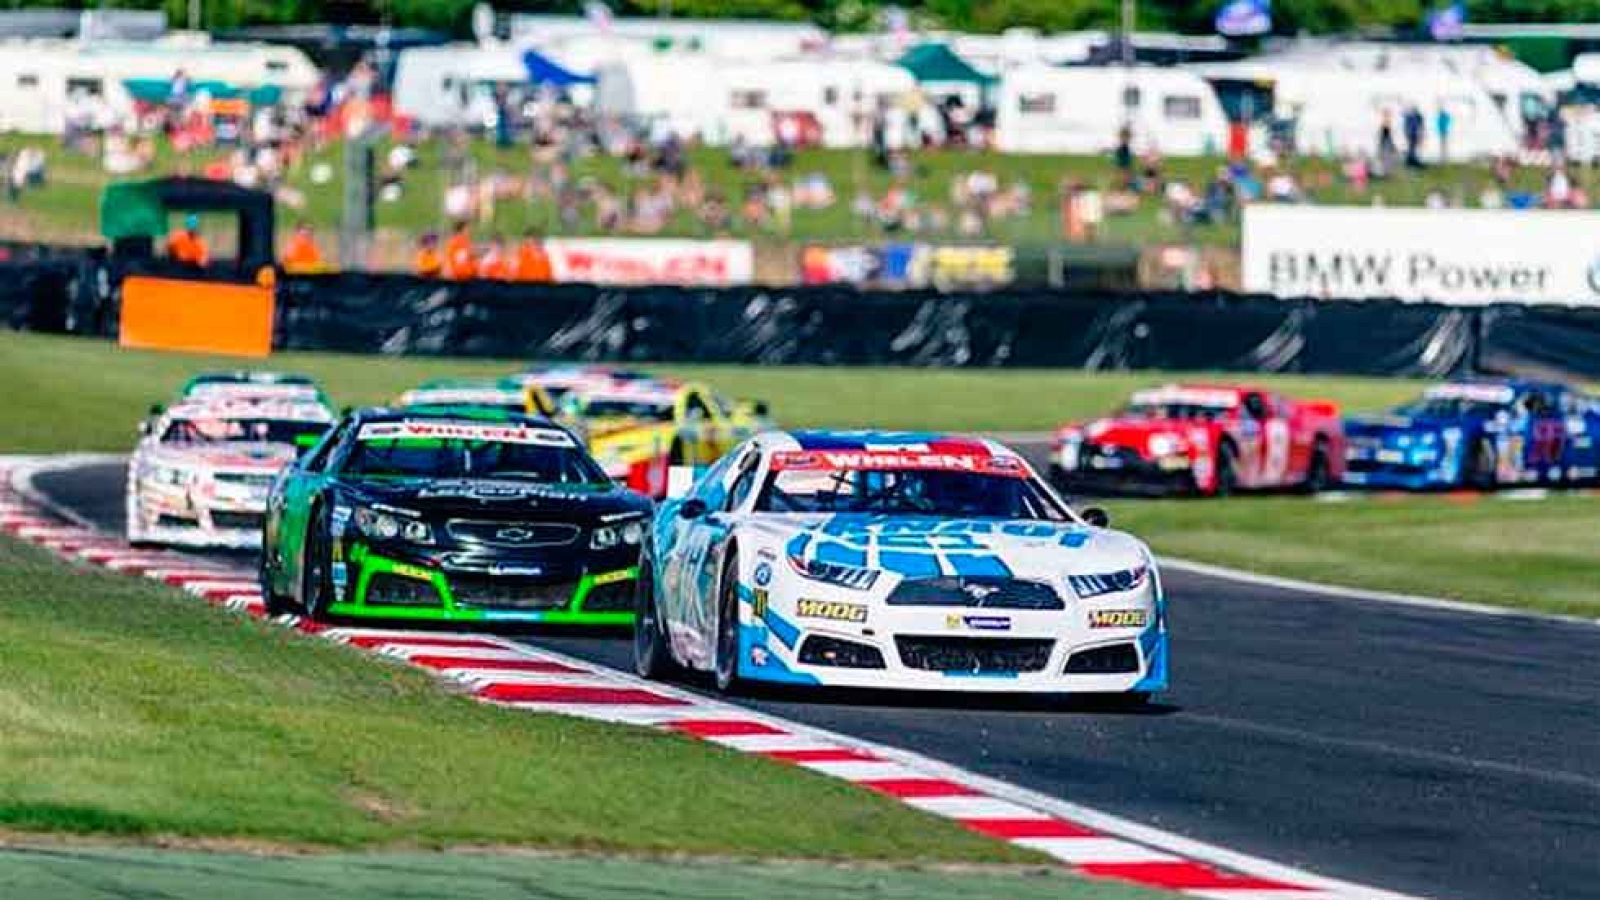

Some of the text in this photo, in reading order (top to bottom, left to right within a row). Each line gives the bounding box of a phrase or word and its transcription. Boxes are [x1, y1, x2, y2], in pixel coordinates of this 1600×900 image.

[1269, 252, 1391, 285] BMW
[1409, 253, 1548, 289] Power
[832, 453, 974, 471] WHELEN
[799, 600, 866, 622] MOOG
